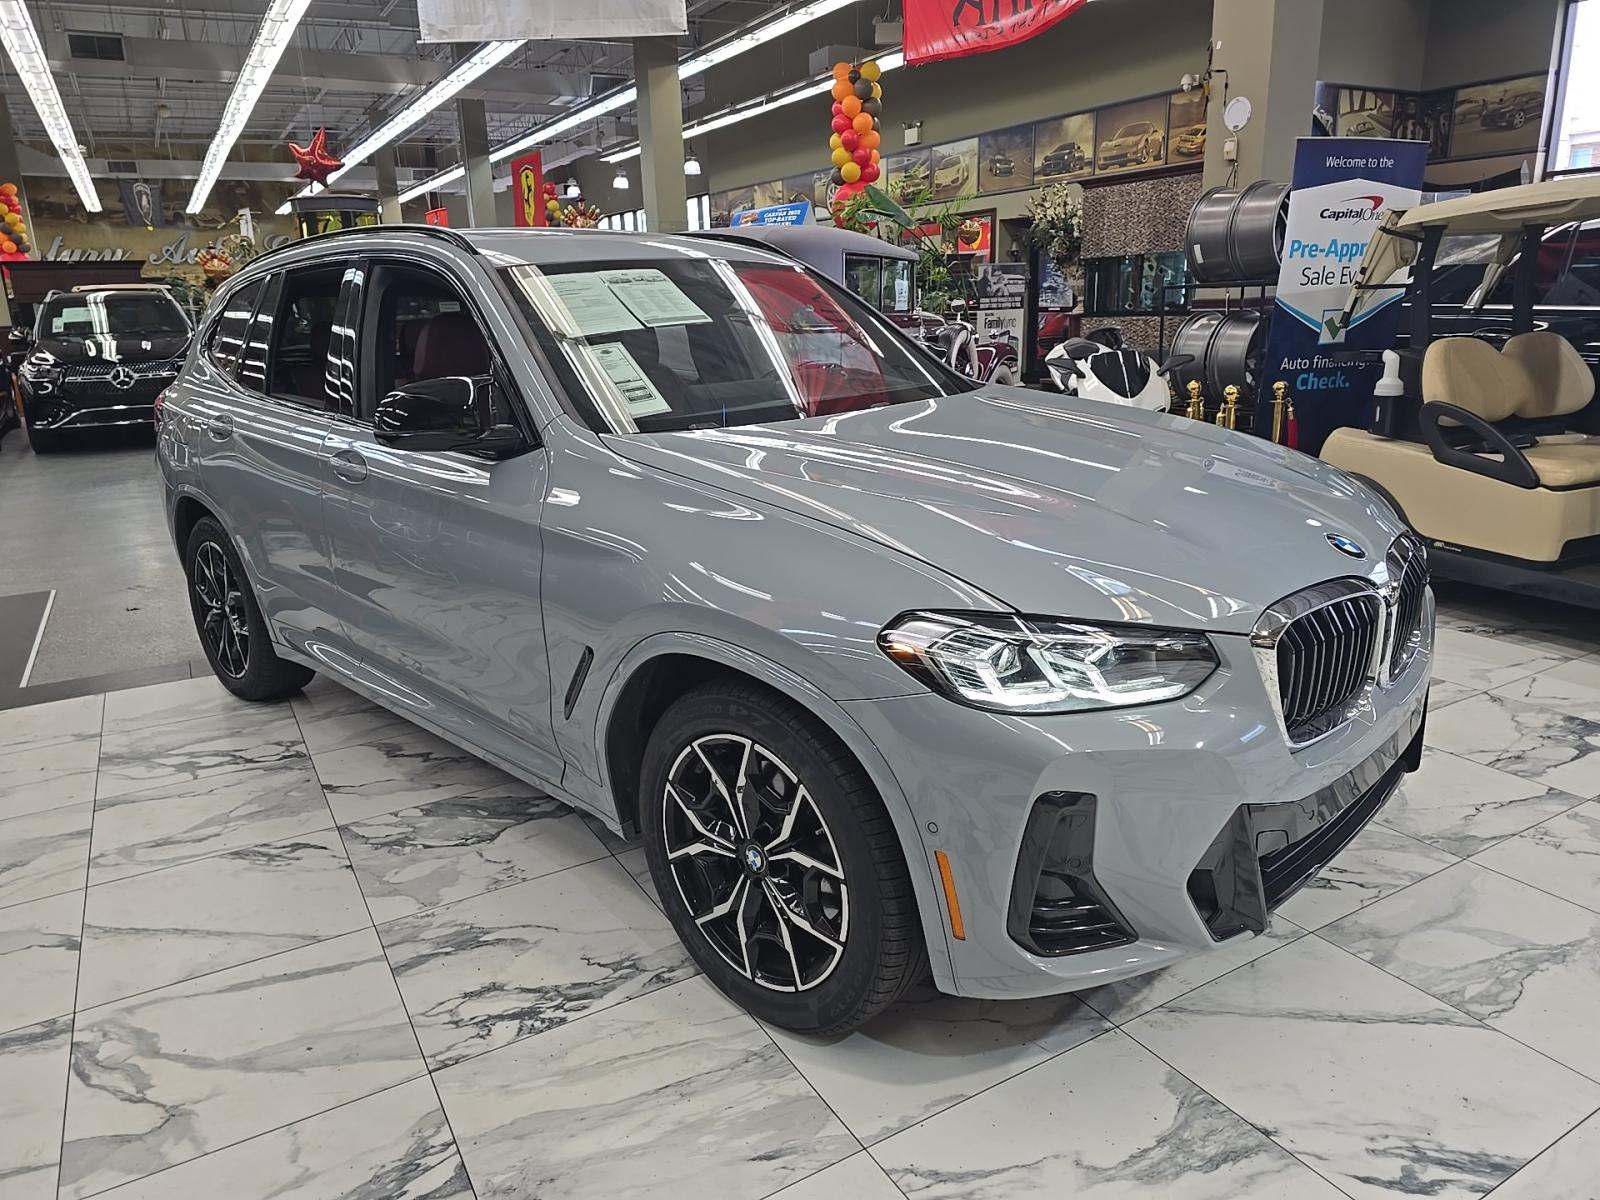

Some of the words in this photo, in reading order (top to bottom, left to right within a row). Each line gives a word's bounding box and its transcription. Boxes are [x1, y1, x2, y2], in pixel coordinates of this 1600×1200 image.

[1326, 155, 1367, 168] Welcome
[1368, 157, 1378, 168] to
[1379, 155, 1394, 168] the
[1289, 239, 1368, 262] Pre-Appr
[1300, 265, 1335, 286] Sale
[1340, 266, 1358, 285] Ev
[1280, 357, 1310, 371] Auto
[1296, 371, 1350, 391] Check.
